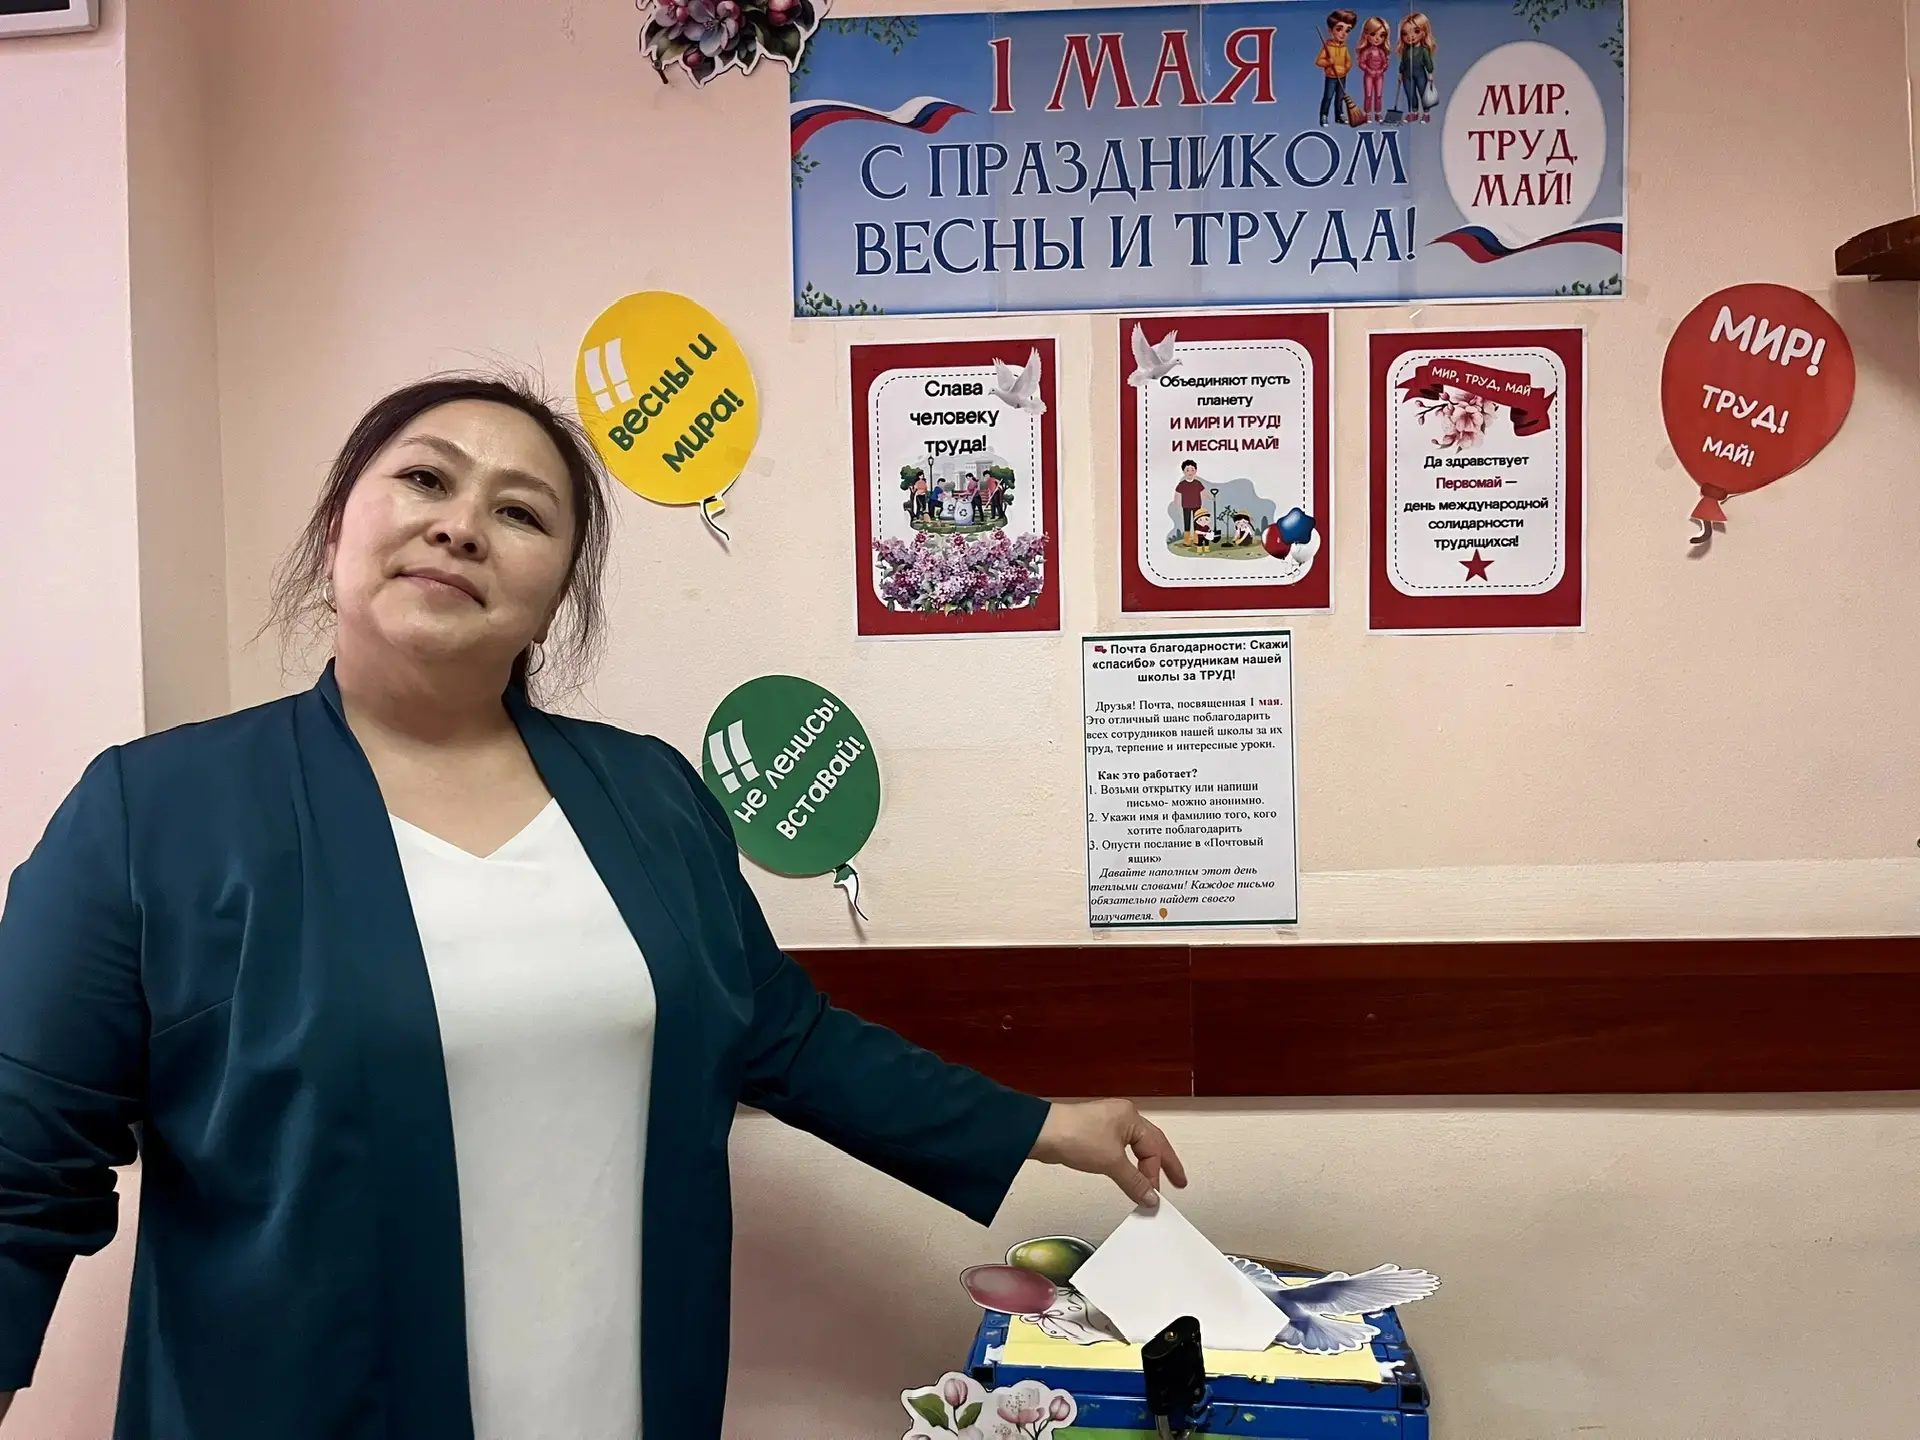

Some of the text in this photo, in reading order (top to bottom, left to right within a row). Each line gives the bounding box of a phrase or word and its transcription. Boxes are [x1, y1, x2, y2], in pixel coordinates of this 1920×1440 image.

[988, 26, 1277, 114] 1 МАЯ
[860, 130, 1409, 205] С ПРАЗДНИКОМ
[1472, 170, 1571, 206] МАЙ!
[854, 205, 1417, 276] ВЕСНЫ И ТРУДА!
[1709, 305, 1826, 376] МИР!
[925, 380, 983, 397] Слава
[1160, 375, 1290, 388] Объединяют пусть
[1432, 367, 1531, 396] МИР, ТРУД, МАЙ
[1197, 396, 1253, 407] планету
[1702, 384, 1789, 434] ТРУД!
[910, 409, 999, 428] человеку
[1171, 415, 1281, 429] И МИР! И ТРУД!
[925, 435, 987, 456] труда!
[1172, 436, 1278, 452] И МЕСЯЦ МАЙ!
[1702, 436, 1755, 467] МАЙ!
[1424, 456, 1529, 469] Да здравствует
[1436, 476, 1502, 491] Первомай
[1404, 497, 1549, 513] день международной
[1428, 518, 1524, 530] солидарности
[1434, 536, 1519, 551] трудящихся!
[1111, 640, 1288, 654] Почта благодарности: Скажи
[1092, 654, 1282, 670] «спасибо» сотрудникам нашей
[1138, 673, 1180, 682] школы
[1200, 669, 1236, 681] ТРУД!
[1095, 698, 1283, 713] Друзья! Почта, посвященная 1 мая.
[1086, 713, 1270, 725] Это отличный шанс поблагодарить
[1086, 731, 1108, 739] всех
[1111, 728, 1177, 740] сотрудников
[1180, 726, 1214, 737] нашей
[1217, 727, 1253, 736] школы
[1270, 726, 1282, 734] их
[1087, 740, 1275, 754] труд, терпение и интересные уроки.
[1098, 769, 1198, 781] Как это работает?
[1089, 783, 1258, 795] 1. Возьми открытку или напиши
[1127, 797, 1264, 808] письмо- можно анонимно.
[1089, 813, 1097, 822] 2.
[1101, 812, 1136, 822] Укажи
[1139, 813, 1159, 821] имя
[1172, 811, 1221, 822] фамилию
[1225, 812, 1250, 820] того,
[1253, 811, 1277, 819] кого
[1127, 825, 1242, 836] хотите поблагодарить
[1090, 840, 1098, 850] 3.
[1102, 840, 1141, 852] Опусти
[1144, 839, 1192, 849] послание
[1204, 837, 1264, 847] «Почтовый
[1128, 855, 1162, 864] ящик»
[1099, 866, 1258, 879] Давайте наполним этот день
[1090, 880, 1275, 892] теплыми словами! Каждое письмо
[1091, 894, 1235, 906] обязательно найдет своего
[1091, 912, 1153, 924] получателя.
